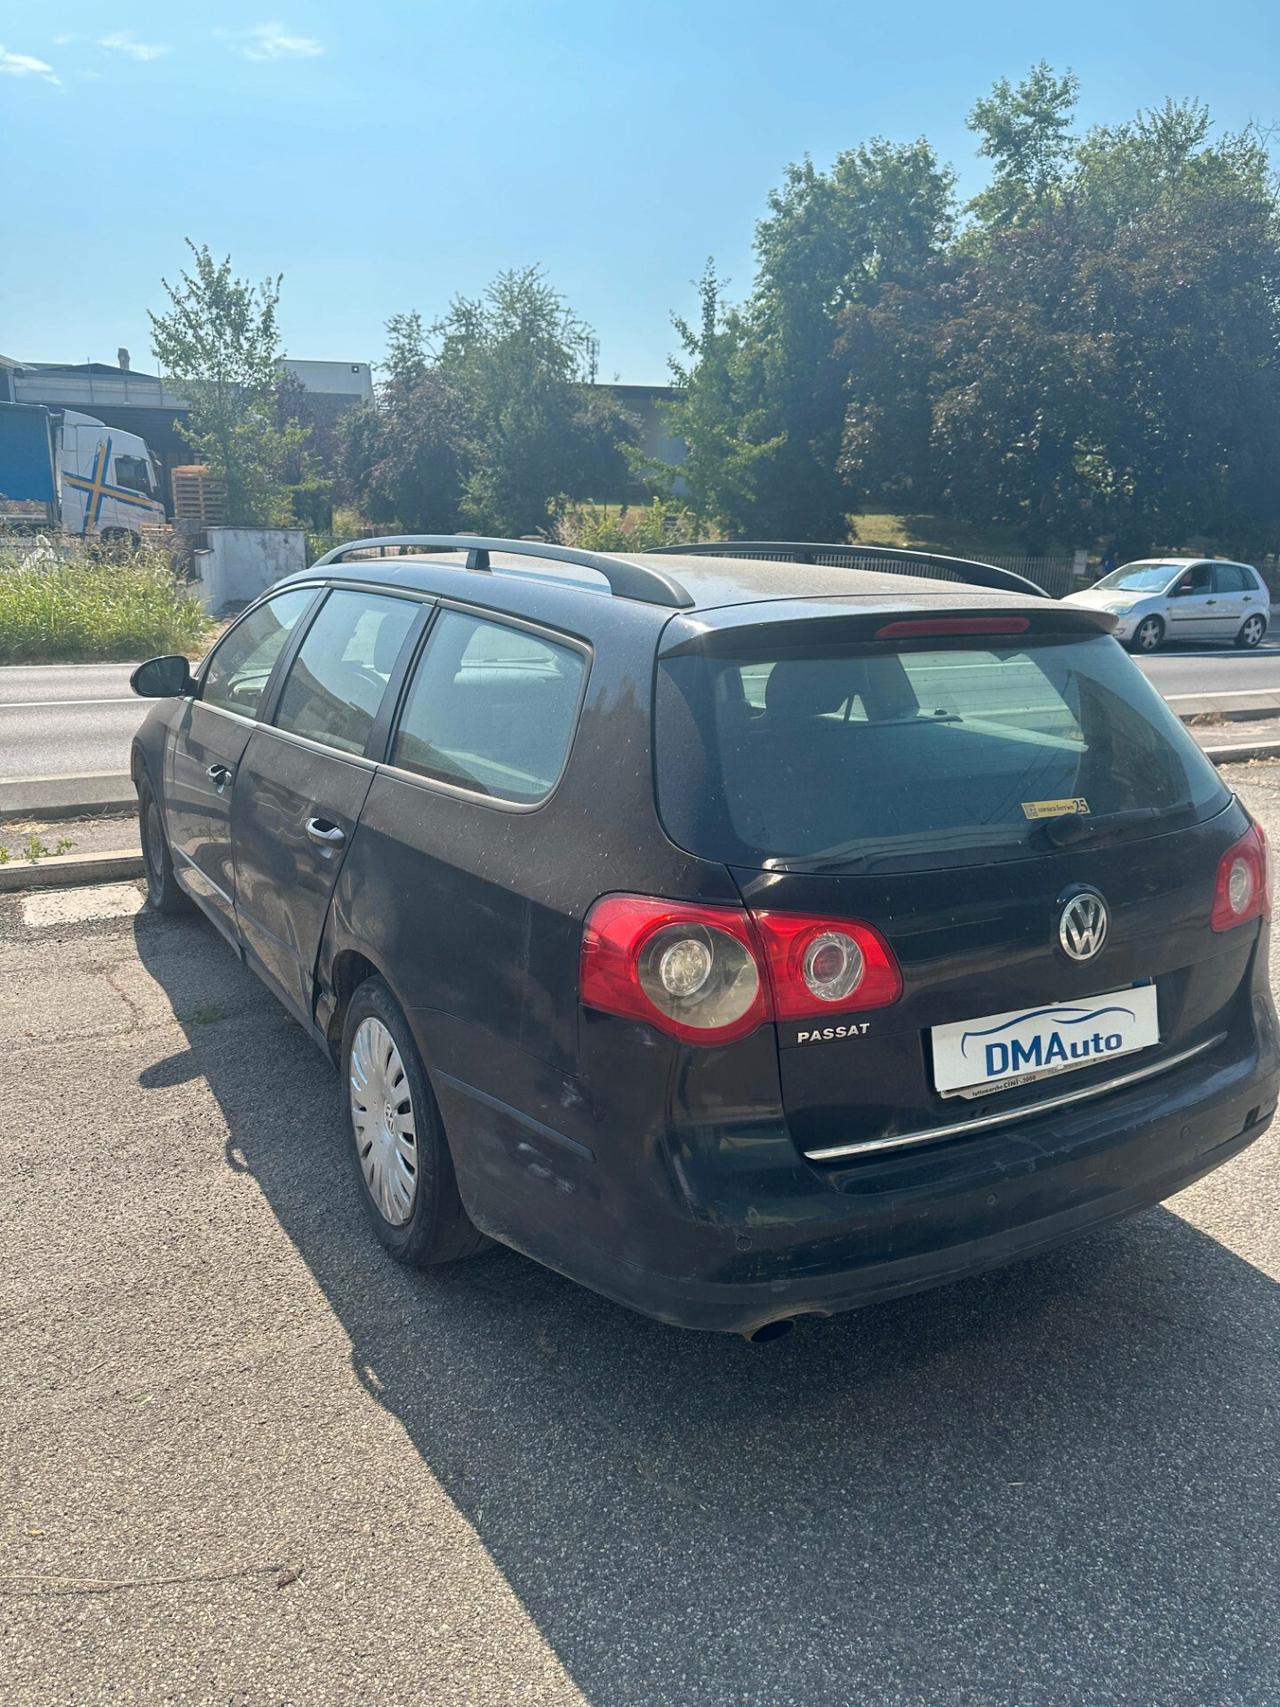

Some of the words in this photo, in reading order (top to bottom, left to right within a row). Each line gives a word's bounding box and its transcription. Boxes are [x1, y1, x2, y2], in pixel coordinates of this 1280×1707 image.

[1072, 799, 1088, 813] 25
[797, 1022, 870, 1044] PASSAT
[985, 1031, 1123, 1077] DMAuto
